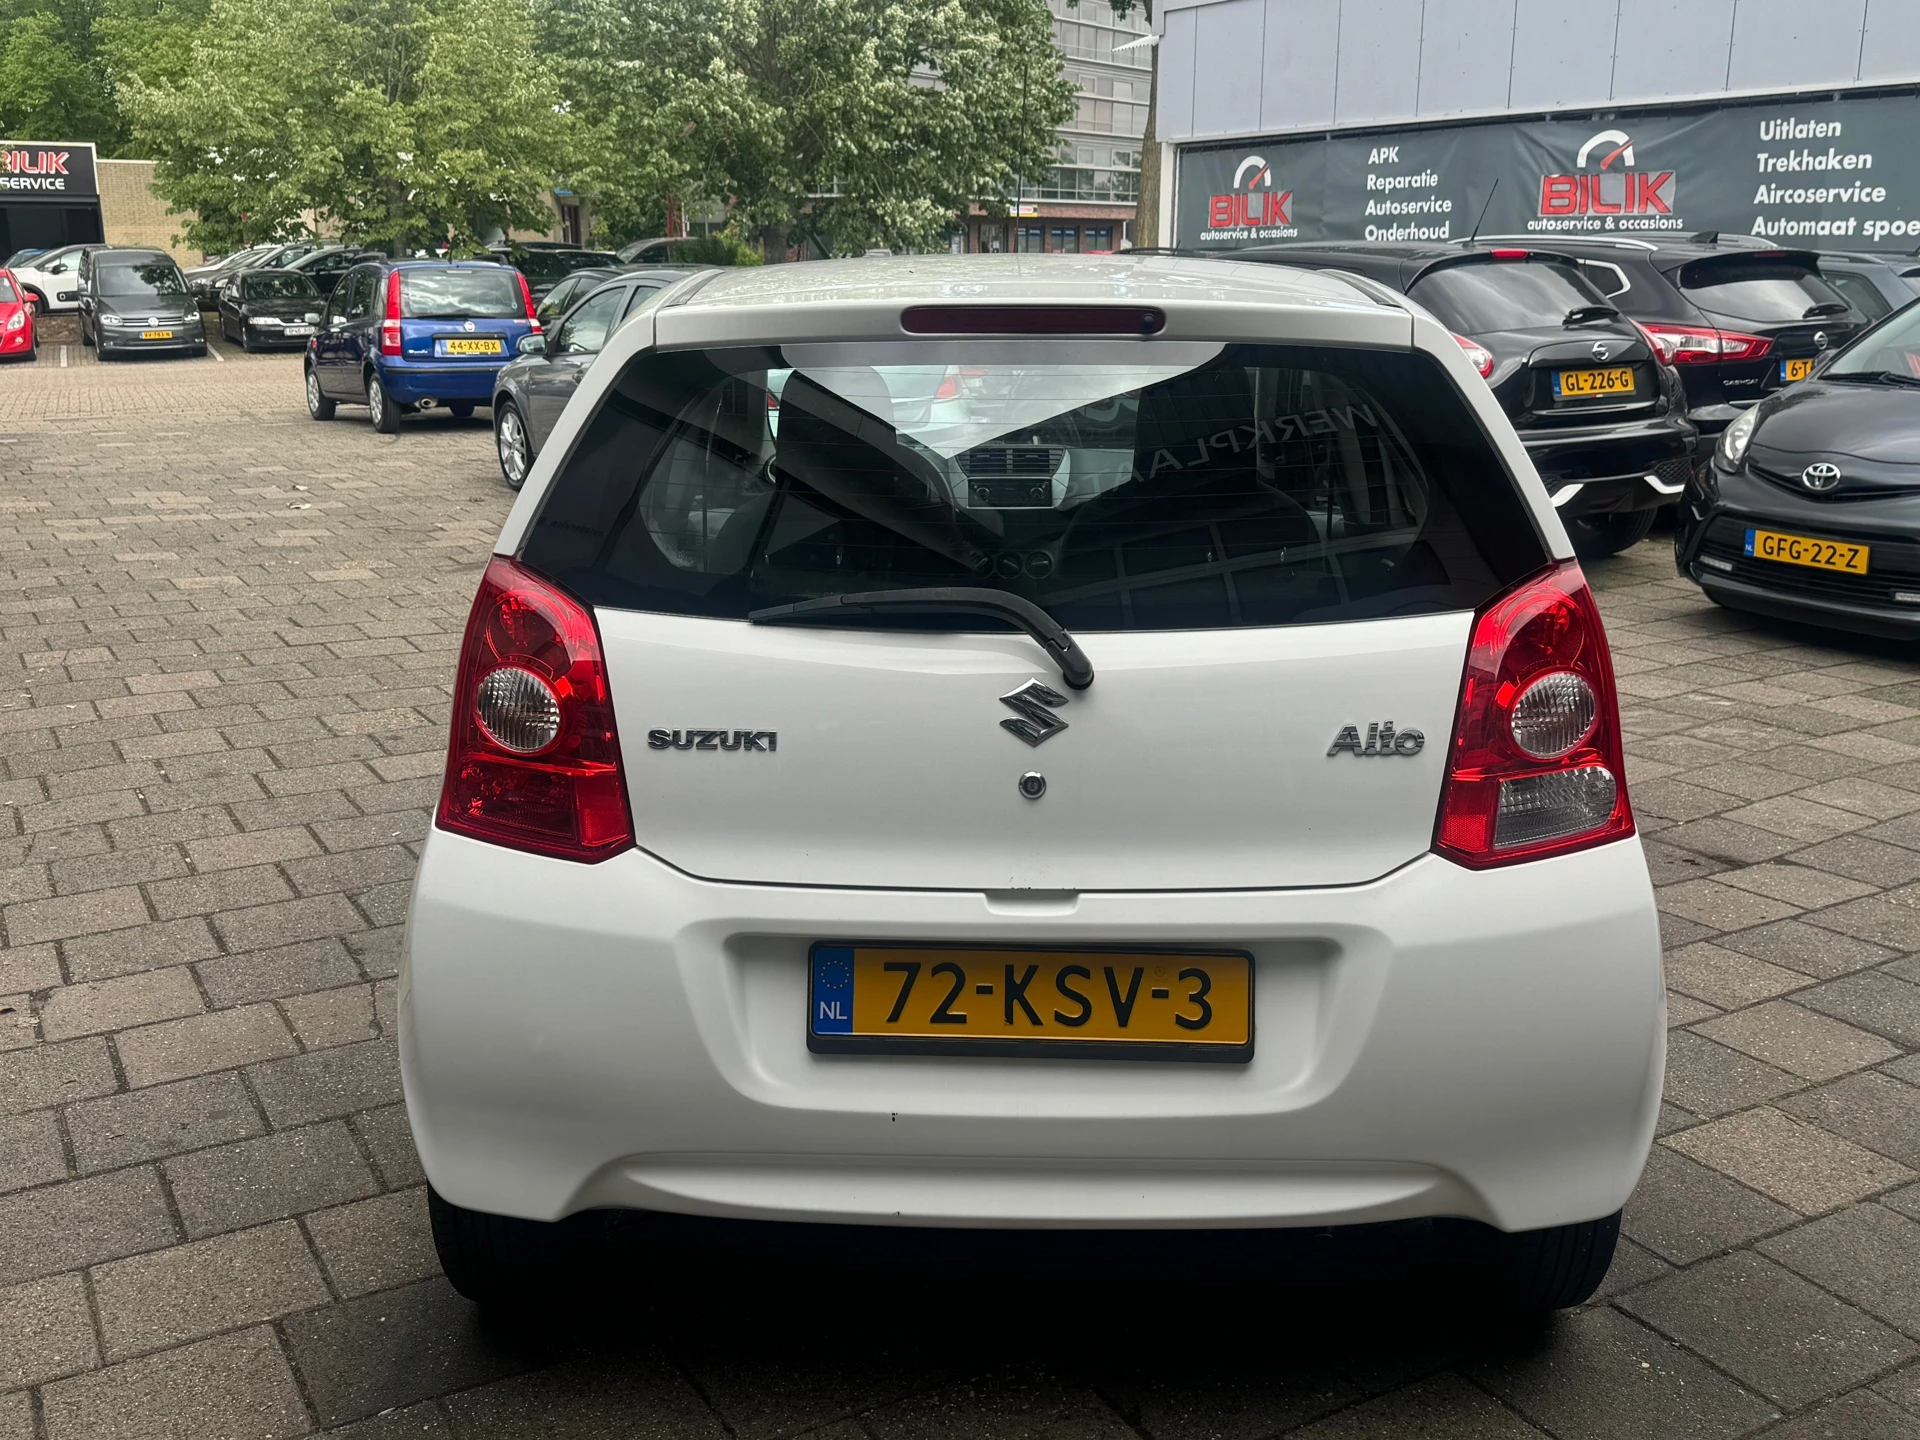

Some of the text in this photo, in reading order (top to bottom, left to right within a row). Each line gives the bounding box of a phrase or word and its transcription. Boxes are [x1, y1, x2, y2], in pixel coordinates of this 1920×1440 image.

[1760, 117, 1842, 141] Uitlaten
[0, 150, 69, 174] ILIK
[1368, 146, 1399, 165] APK
[1756, 147, 1872, 172] Trekhaken
[1367, 169, 1438, 194] Reparatie
[1541, 172, 1674, 215] BILIK
[1753, 180, 1886, 204] Aircoservice
[1209, 190, 1293, 228] BILIK
[1365, 195, 1452, 216] Autoservice
[1200, 226, 1298, 240] autoservice & occasions
[1365, 220, 1450, 241] Onderhoud
[1527, 215, 1683, 230] autoservice & occasions
[1751, 216, 1920, 242] Automaat spoe
[450, 341, 498, 351] 44-XX-BX
[1565, 370, 1629, 391] GL-226-G
[1791, 361, 1813, 377] 6-T
[1763, 536, 1859, 569] GFG-22-Z
[648, 728, 777, 751] SUZUKI
[1327, 721, 1425, 756] Alto
[883, 962, 1213, 1031] 72-KSV-3
[819, 1001, 847, 1020] NL
